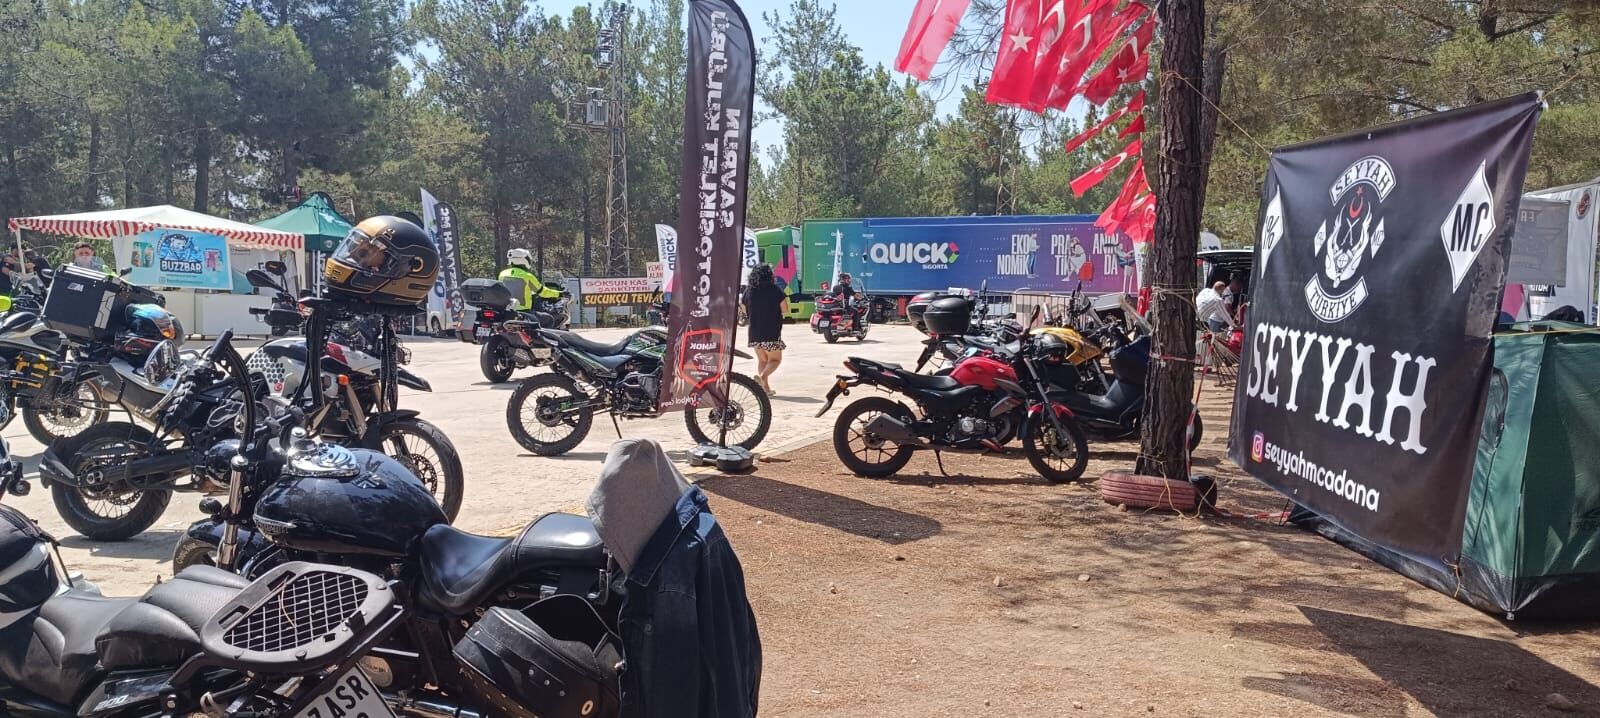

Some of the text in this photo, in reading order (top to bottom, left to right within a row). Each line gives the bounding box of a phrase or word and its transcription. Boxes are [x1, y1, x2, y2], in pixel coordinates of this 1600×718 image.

[1335, 160, 1391, 197] SEYYAH
[1450, 201, 1490, 253] MC
[870, 242, 949, 264] QUICK
[1011, 234, 1030, 254] EKO
[161, 260, 202, 273] BUZZBAR
[1104, 255, 1118, 275] DA
[1246, 322, 1437, 455] SEYYAH
[1264, 439, 1381, 512] seyyahmcadana
